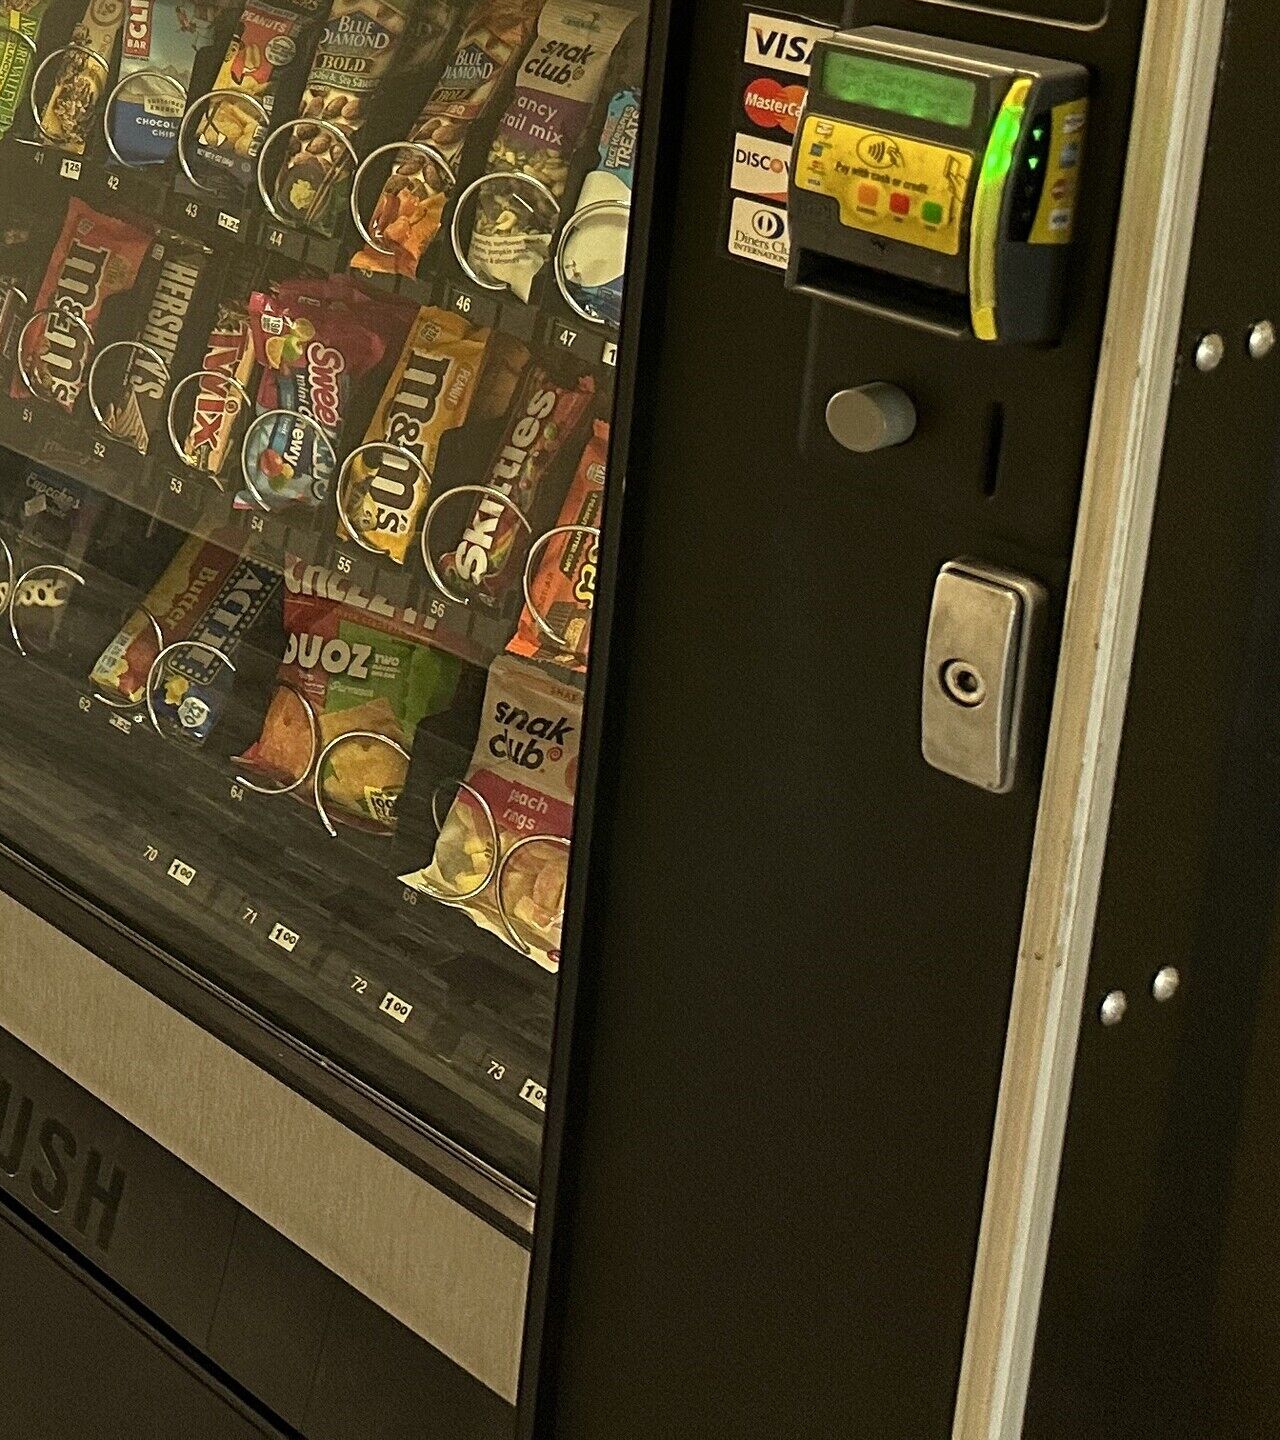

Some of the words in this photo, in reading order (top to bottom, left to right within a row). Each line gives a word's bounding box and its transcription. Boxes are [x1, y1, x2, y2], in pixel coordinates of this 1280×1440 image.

[240, 9, 288, 34] PEANUTS
[338, 15, 375, 35] BLUE
[126, 38, 147, 51] BAR
[540, 37, 597, 67] snak
[752, 27, 811, 65] VIS
[320, 54, 367, 73] BOLD
[454, 49, 485, 67] BLUE
[523, 57, 574, 87] club
[515, 96, 560, 120] ancy
[151, 127, 177, 140] CHIP
[528, 124, 564, 146] mix
[107, 175, 120, 190] 42
[185, 202, 199, 218] 43
[269, 230, 284, 246] 44
[735, 229, 769, 251] Diners
[455, 295, 472, 313] 46
[133, 260, 199, 400] HERSHEY'S
[559, 329, 578, 347] 47
[445, 362, 474, 406] PEANUT
[22, 408, 34, 423] 51
[93, 441, 107, 457] 52
[169, 476, 183, 494] 53
[250, 516, 265, 533] 54
[336, 556, 352, 573] 55
[163, 566, 220, 630] Butter
[208, 568, 265, 633] ACT
[429, 599, 446, 618] 56
[78, 696, 90, 713] 62
[494, 700, 574, 747] snak
[230, 785, 244, 801] 64
[143, 845, 159, 862] 70
[402, 887, 418, 905] 66
[242, 906, 258, 924] 71
[350, 976, 368, 994] 72
[486, 1061, 505, 1080] 73
